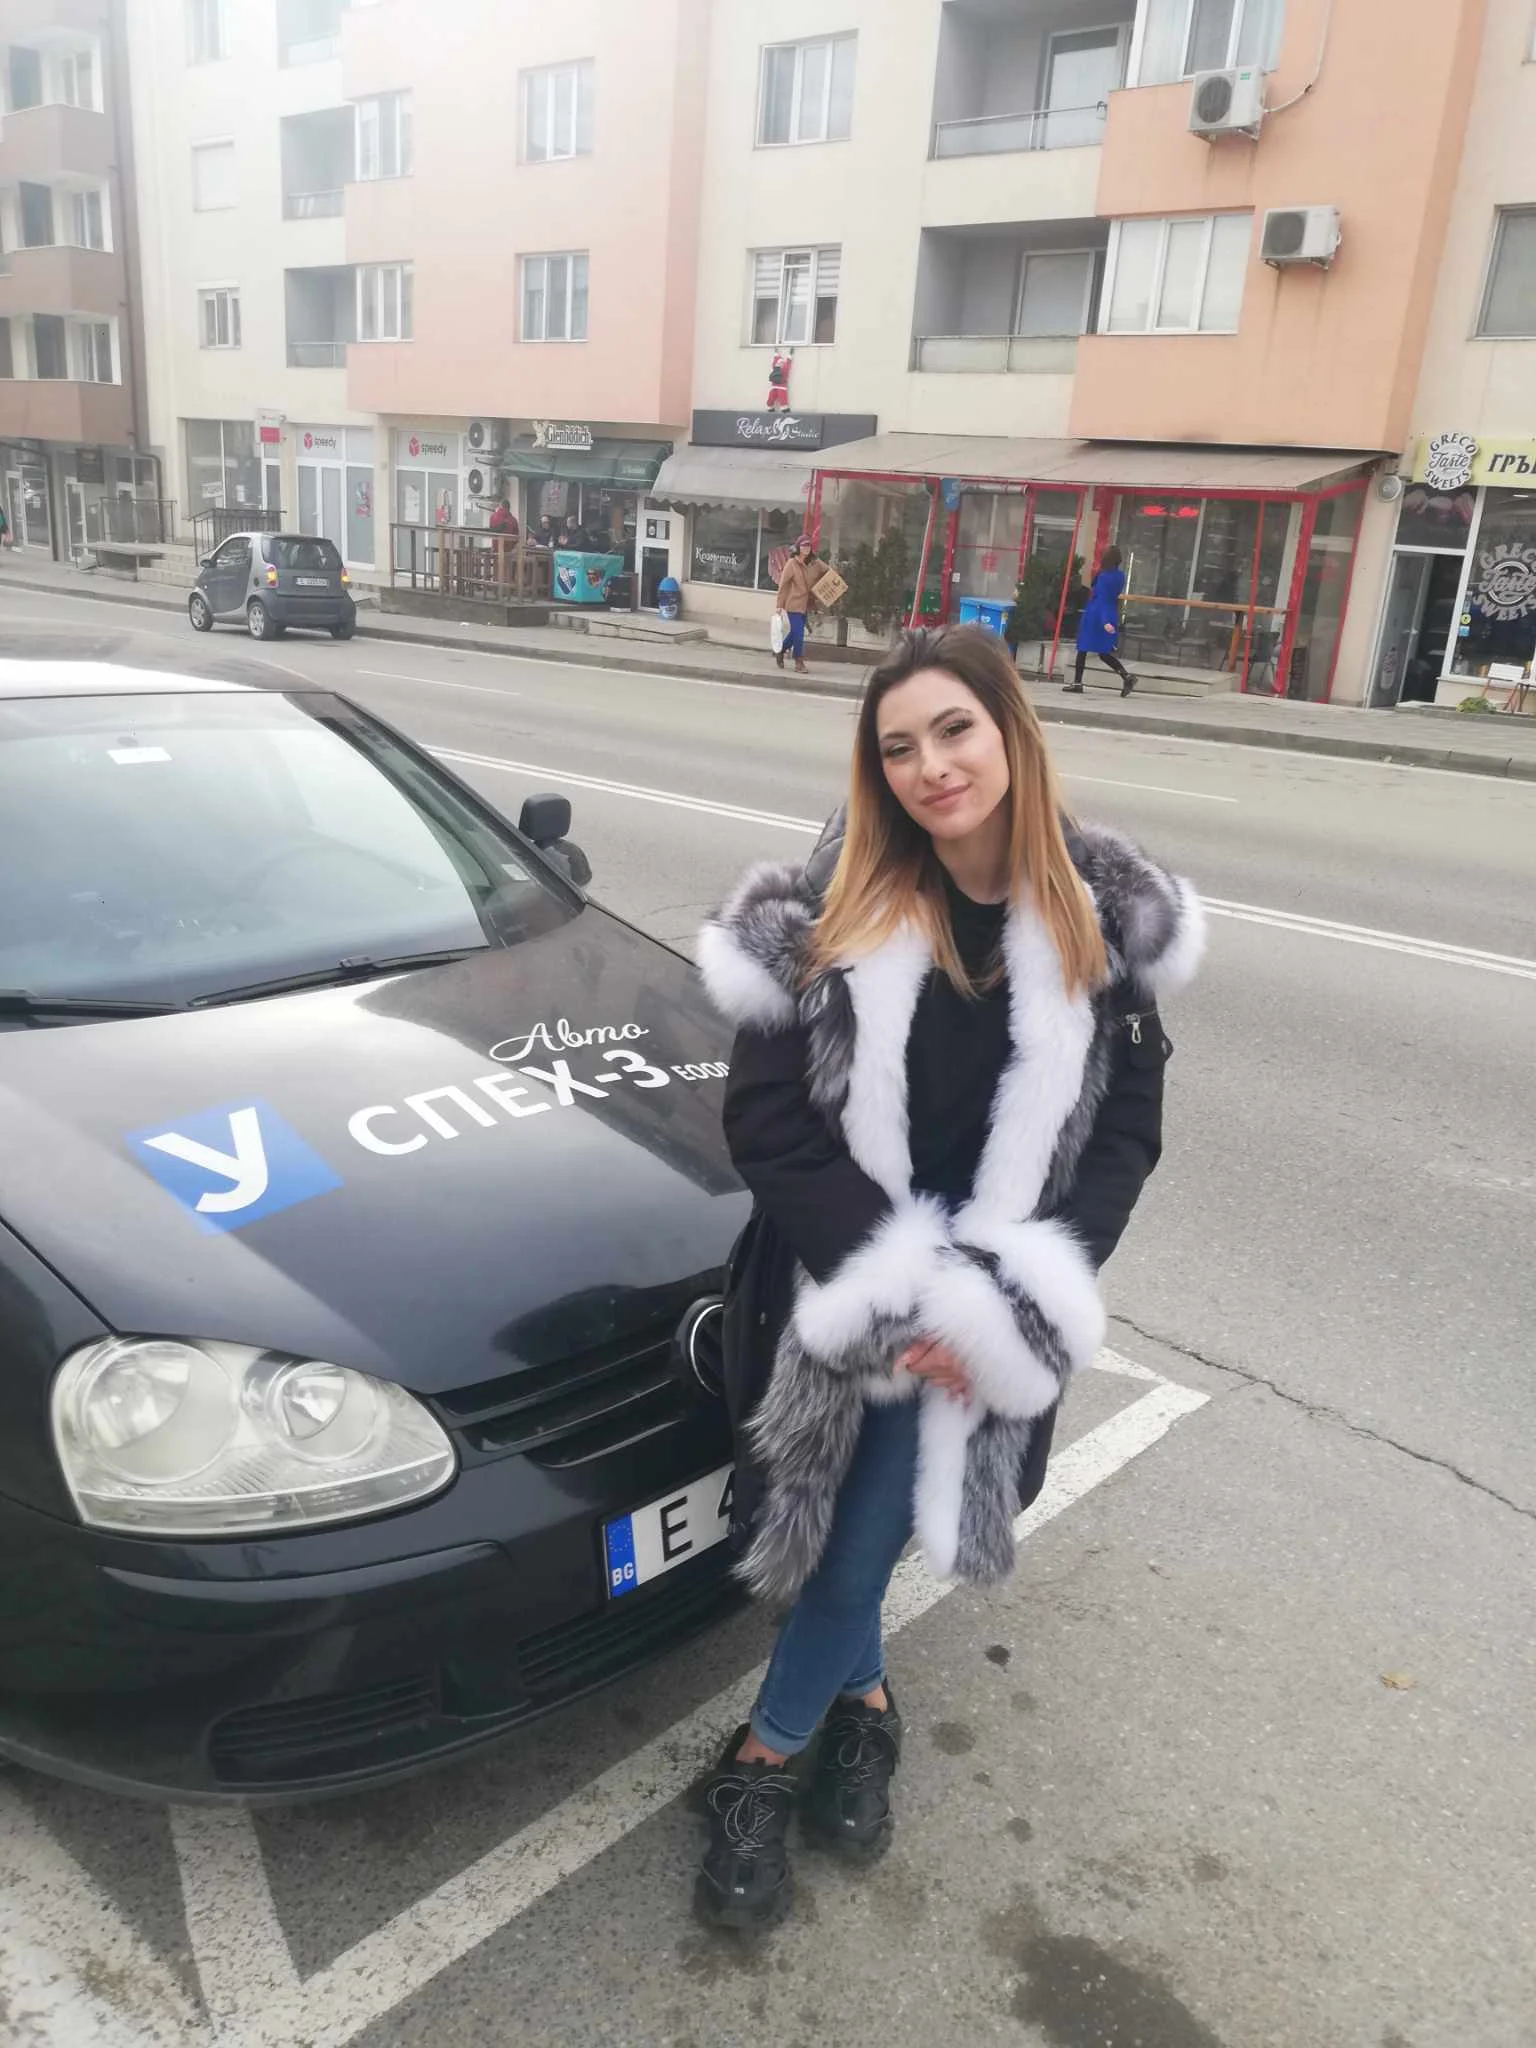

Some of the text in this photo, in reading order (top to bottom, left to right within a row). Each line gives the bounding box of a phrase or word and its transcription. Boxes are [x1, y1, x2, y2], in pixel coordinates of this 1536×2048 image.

[736, 417, 772, 439] Relax
[1430, 432, 1477, 454] GRECO
[1429, 452, 1469, 469] Taste
[1424, 470, 1470, 489] SWEETS
[489, 1018, 649, 1062] Авто
[660, 1496, 693, 1562] E
[611, 1562, 635, 1586] BG
